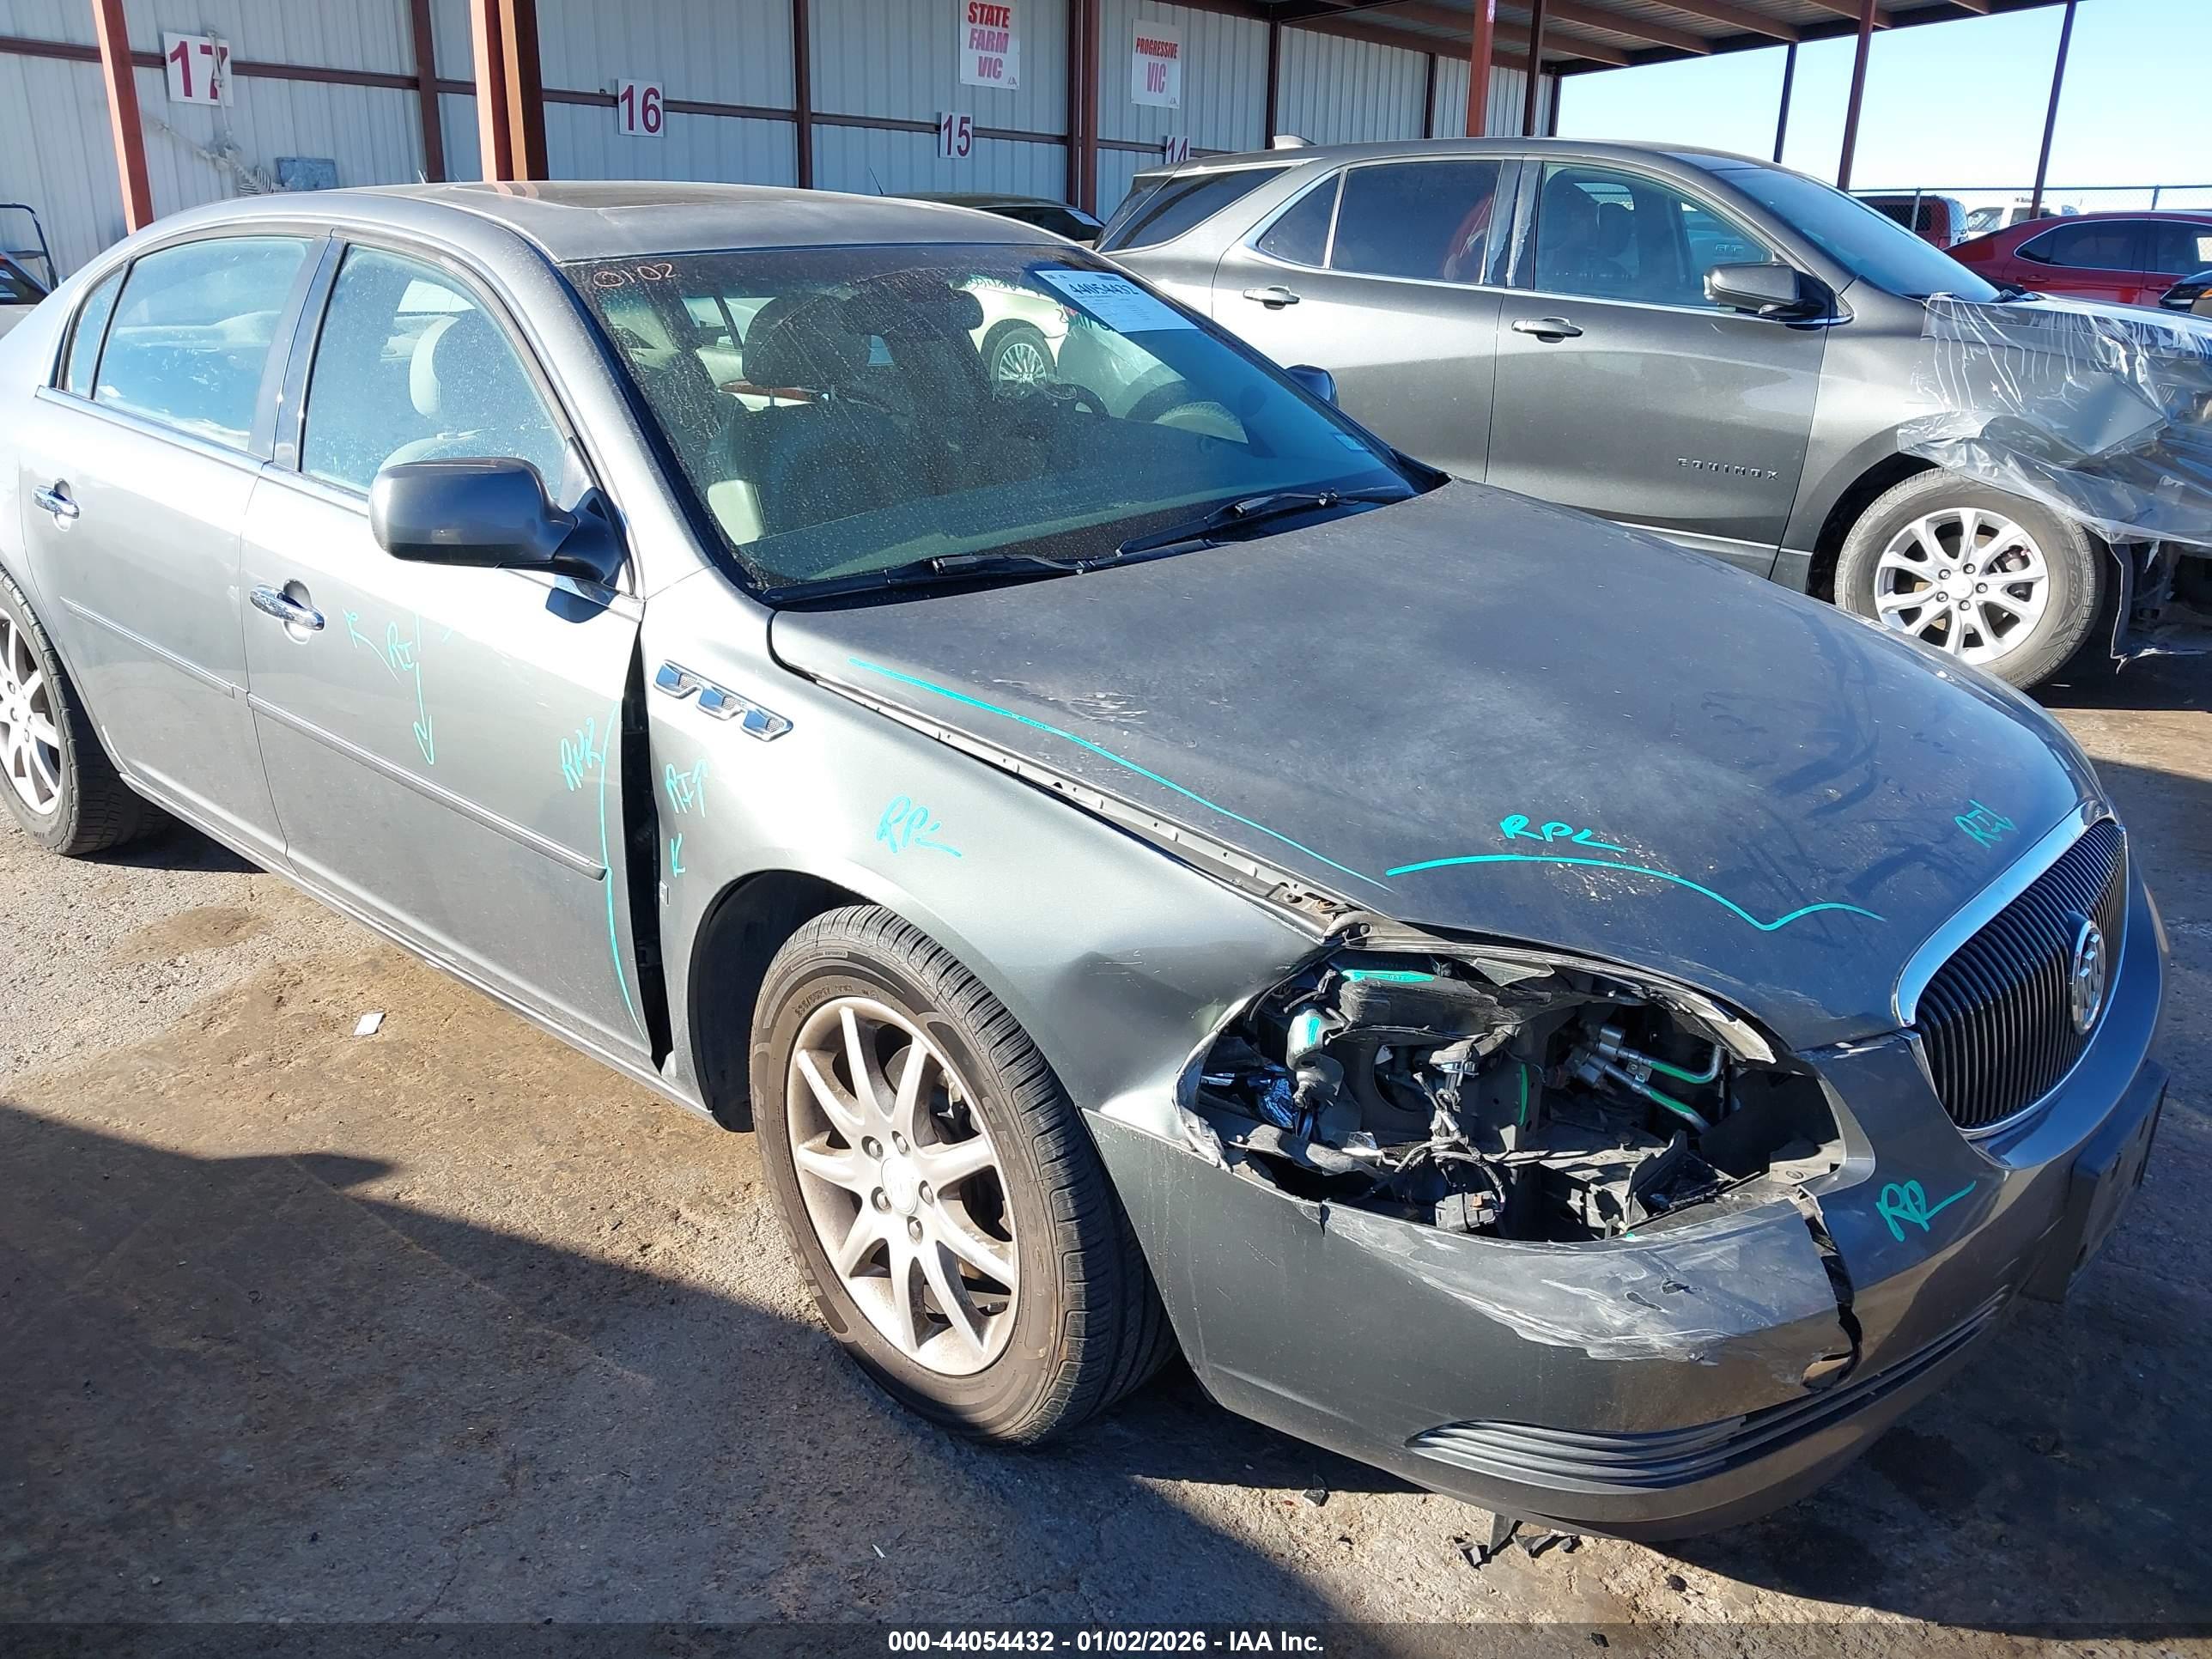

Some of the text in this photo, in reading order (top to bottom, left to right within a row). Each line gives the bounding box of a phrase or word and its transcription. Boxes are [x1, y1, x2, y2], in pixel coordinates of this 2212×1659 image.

[968, 1, 1011, 29] STATE
[968, 27, 1009, 54] FARM
[1135, 37, 1179, 59] PROGRESSIVE
[169, 40, 228, 100] 17
[977, 56, 1003, 80] VIC
[1146, 61, 1167, 94] VIC
[620, 84, 661, 133] 16
[943, 114, 971, 157] 15
[1167, 137, 1188, 163] 14
[593, 263, 678, 287] 0102
[1069, 283, 1139, 295] 44054432
[1677, 458, 1778, 480] EQUINOX
